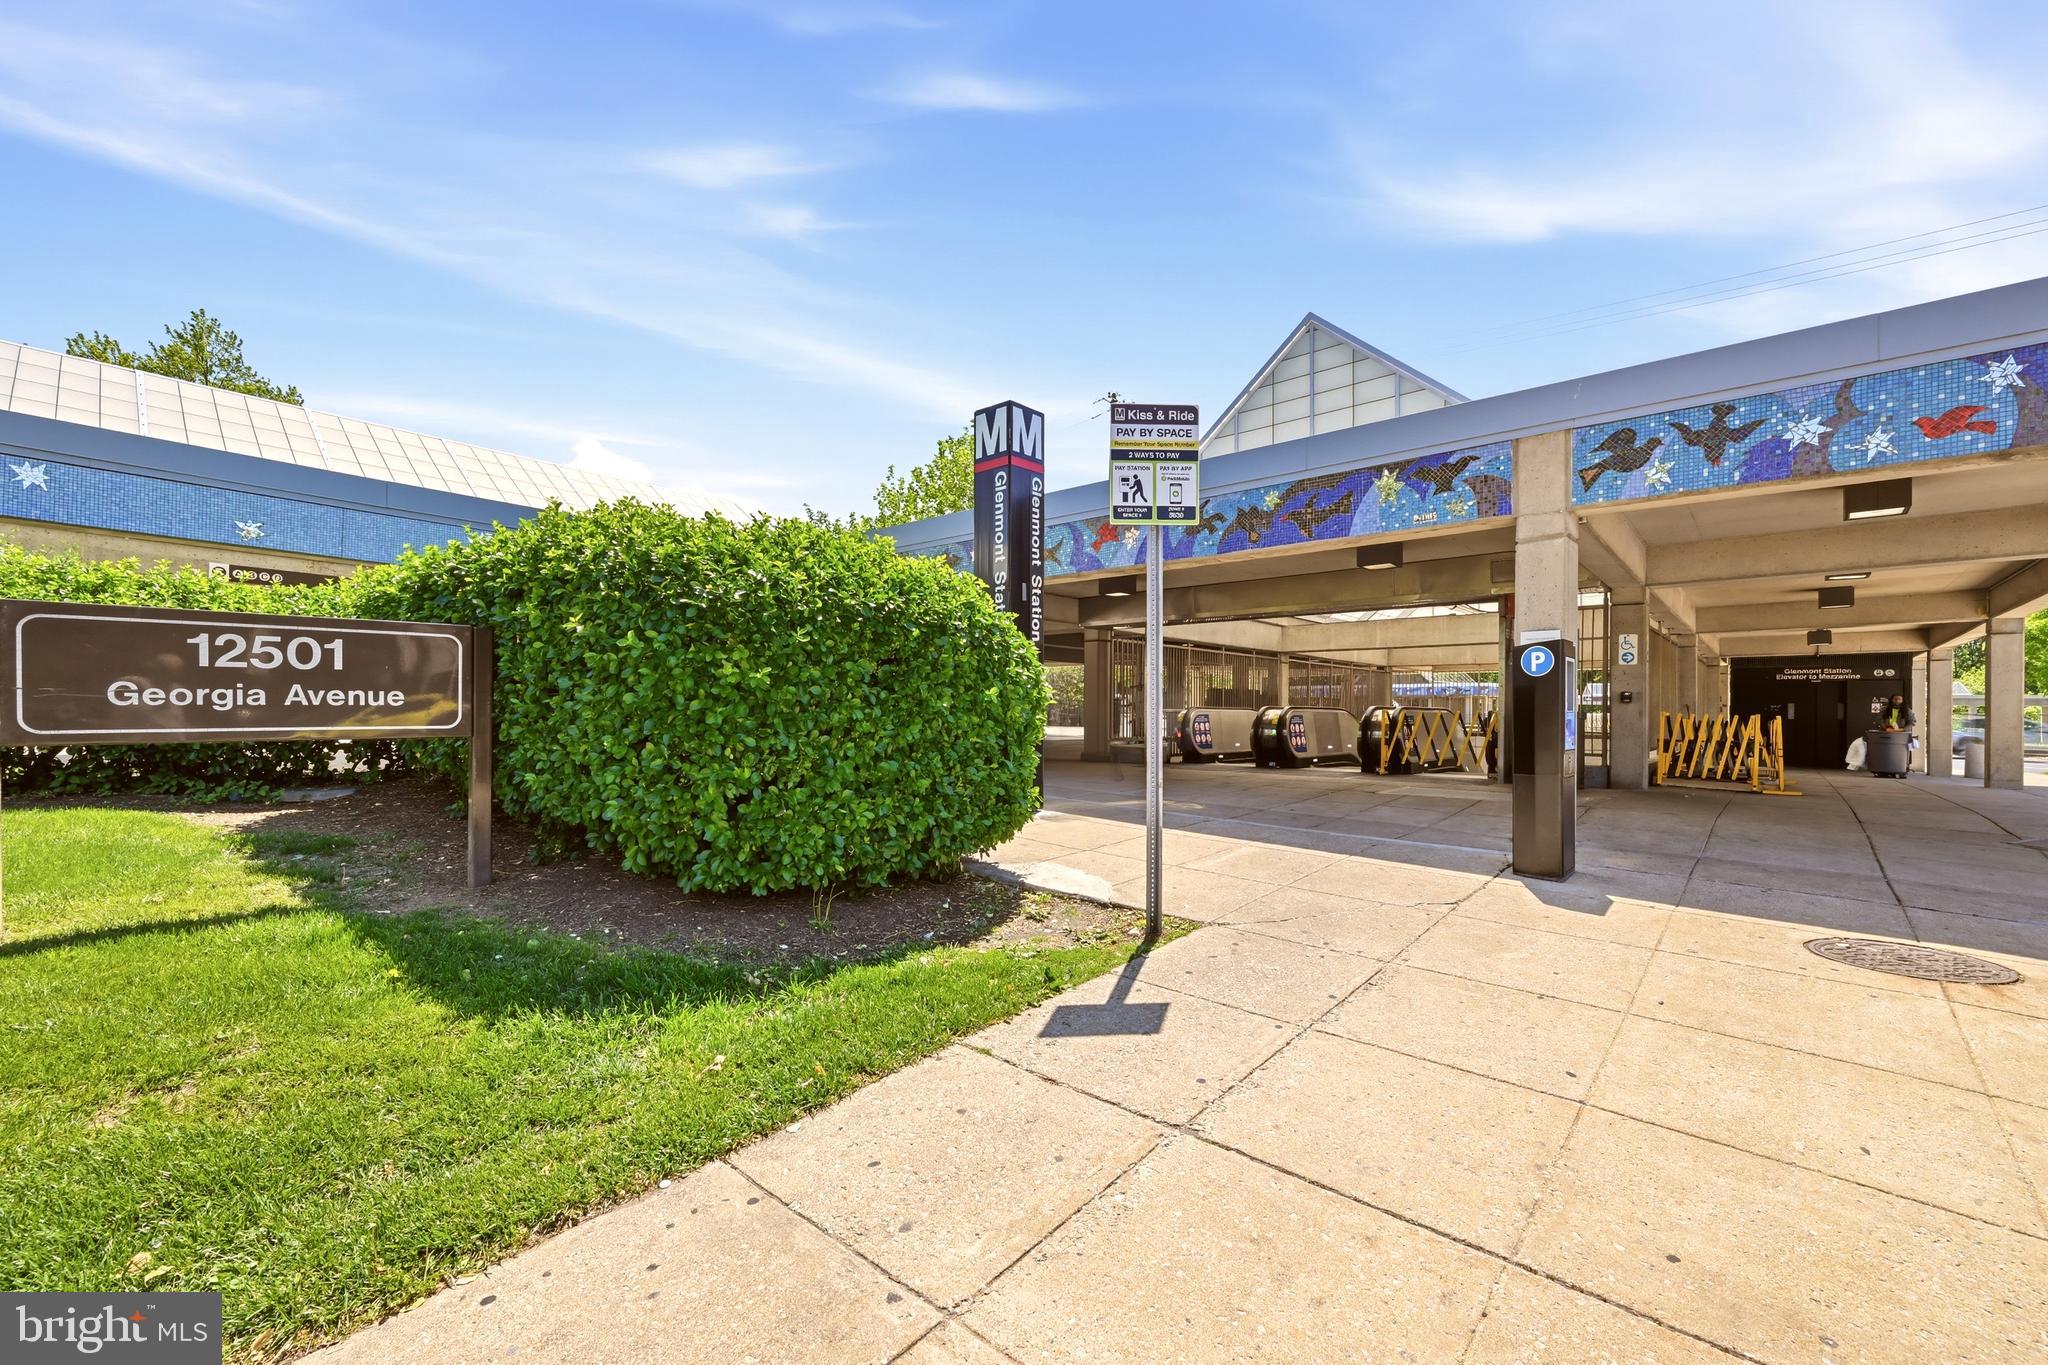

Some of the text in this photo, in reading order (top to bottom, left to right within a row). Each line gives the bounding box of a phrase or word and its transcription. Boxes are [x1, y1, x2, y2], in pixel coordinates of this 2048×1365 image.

[976, 406, 1007, 460] M
[1012, 406, 1042, 460] M
[1116, 428, 1192, 438] PAY BY SPACE
[1128, 410, 1153, 420] Kiss
[1156, 410, 1165, 420] &
[1168, 410, 1194, 420] Ride
[994, 471, 1007, 612] Glenmont Stat
[1032, 476, 1042, 642] Glenmont Station
[186, 633, 344, 670] 12501
[1531, 652, 1546, 672] P
[106, 680, 405, 711] Georgia Avenue
